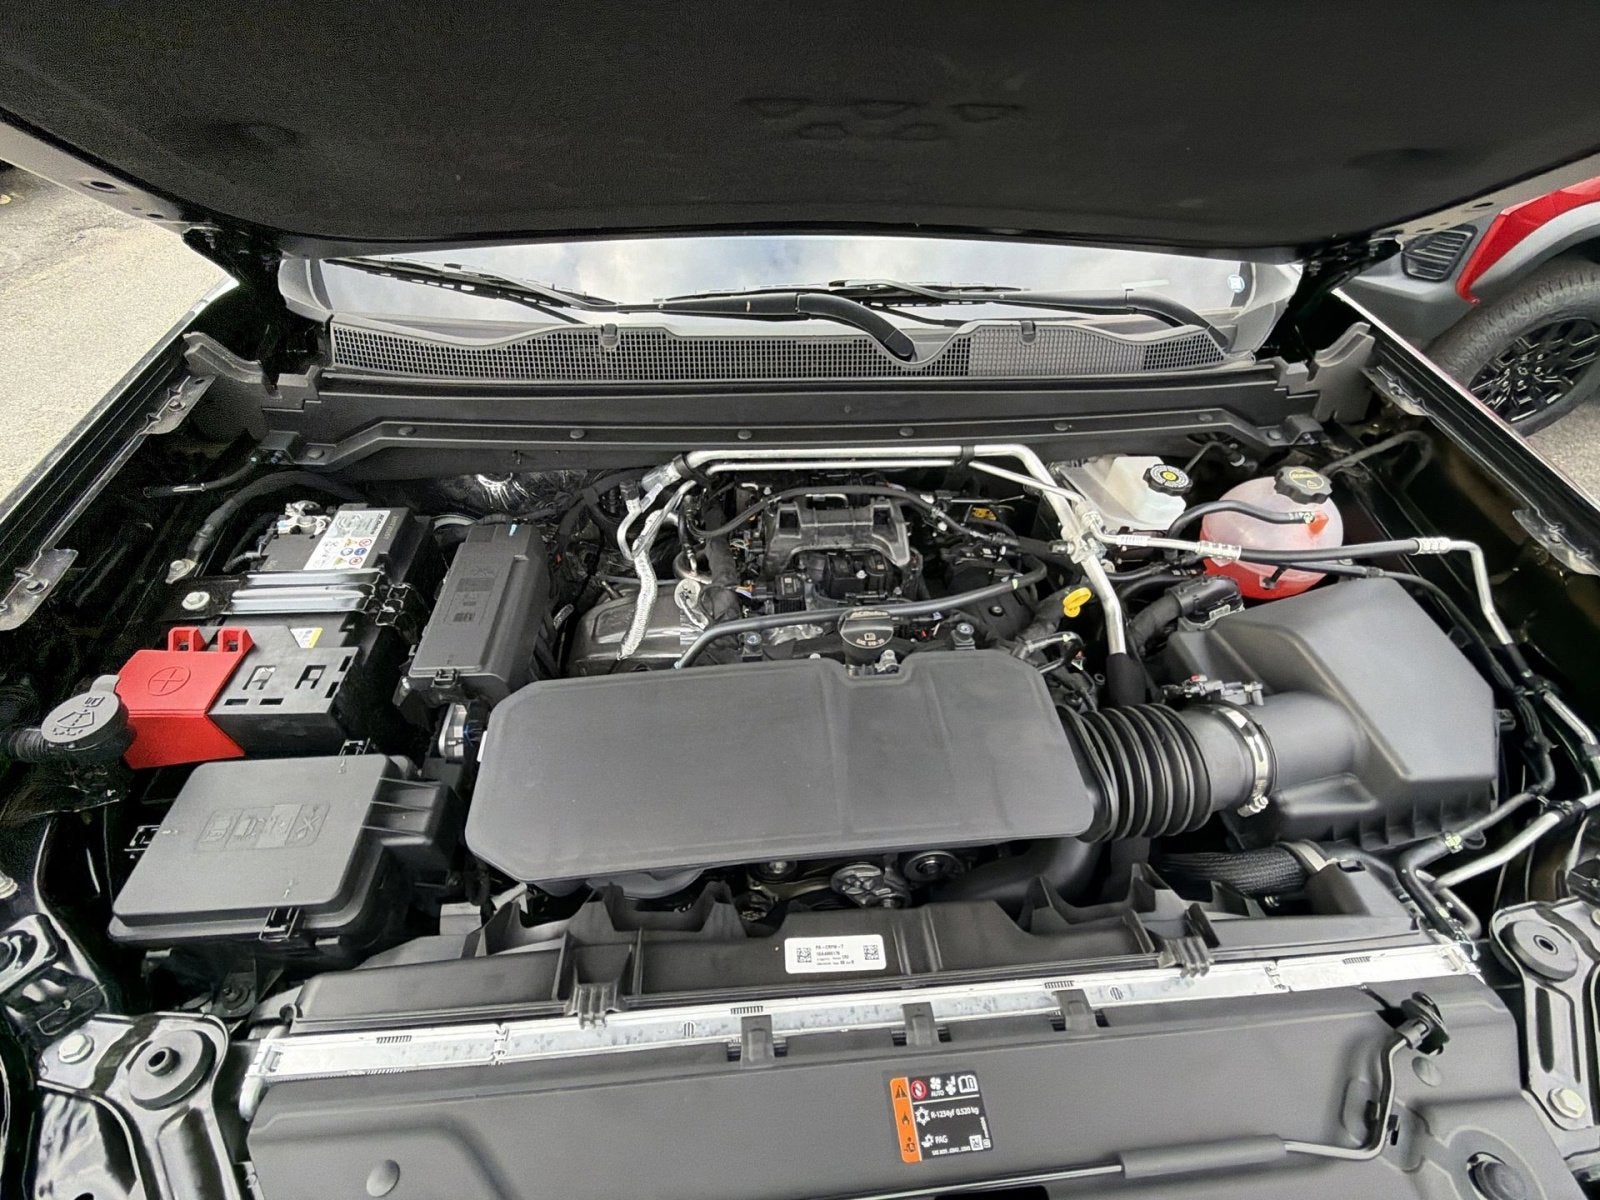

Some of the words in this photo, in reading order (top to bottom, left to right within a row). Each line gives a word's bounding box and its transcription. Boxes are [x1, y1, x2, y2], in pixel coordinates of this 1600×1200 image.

[930, 1109, 954, 1118] R-1234yf
[956, 1107, 971, 1116] 0.520
[971, 1106, 979, 1115] kg
[934, 1135, 948, 1144] PAG
